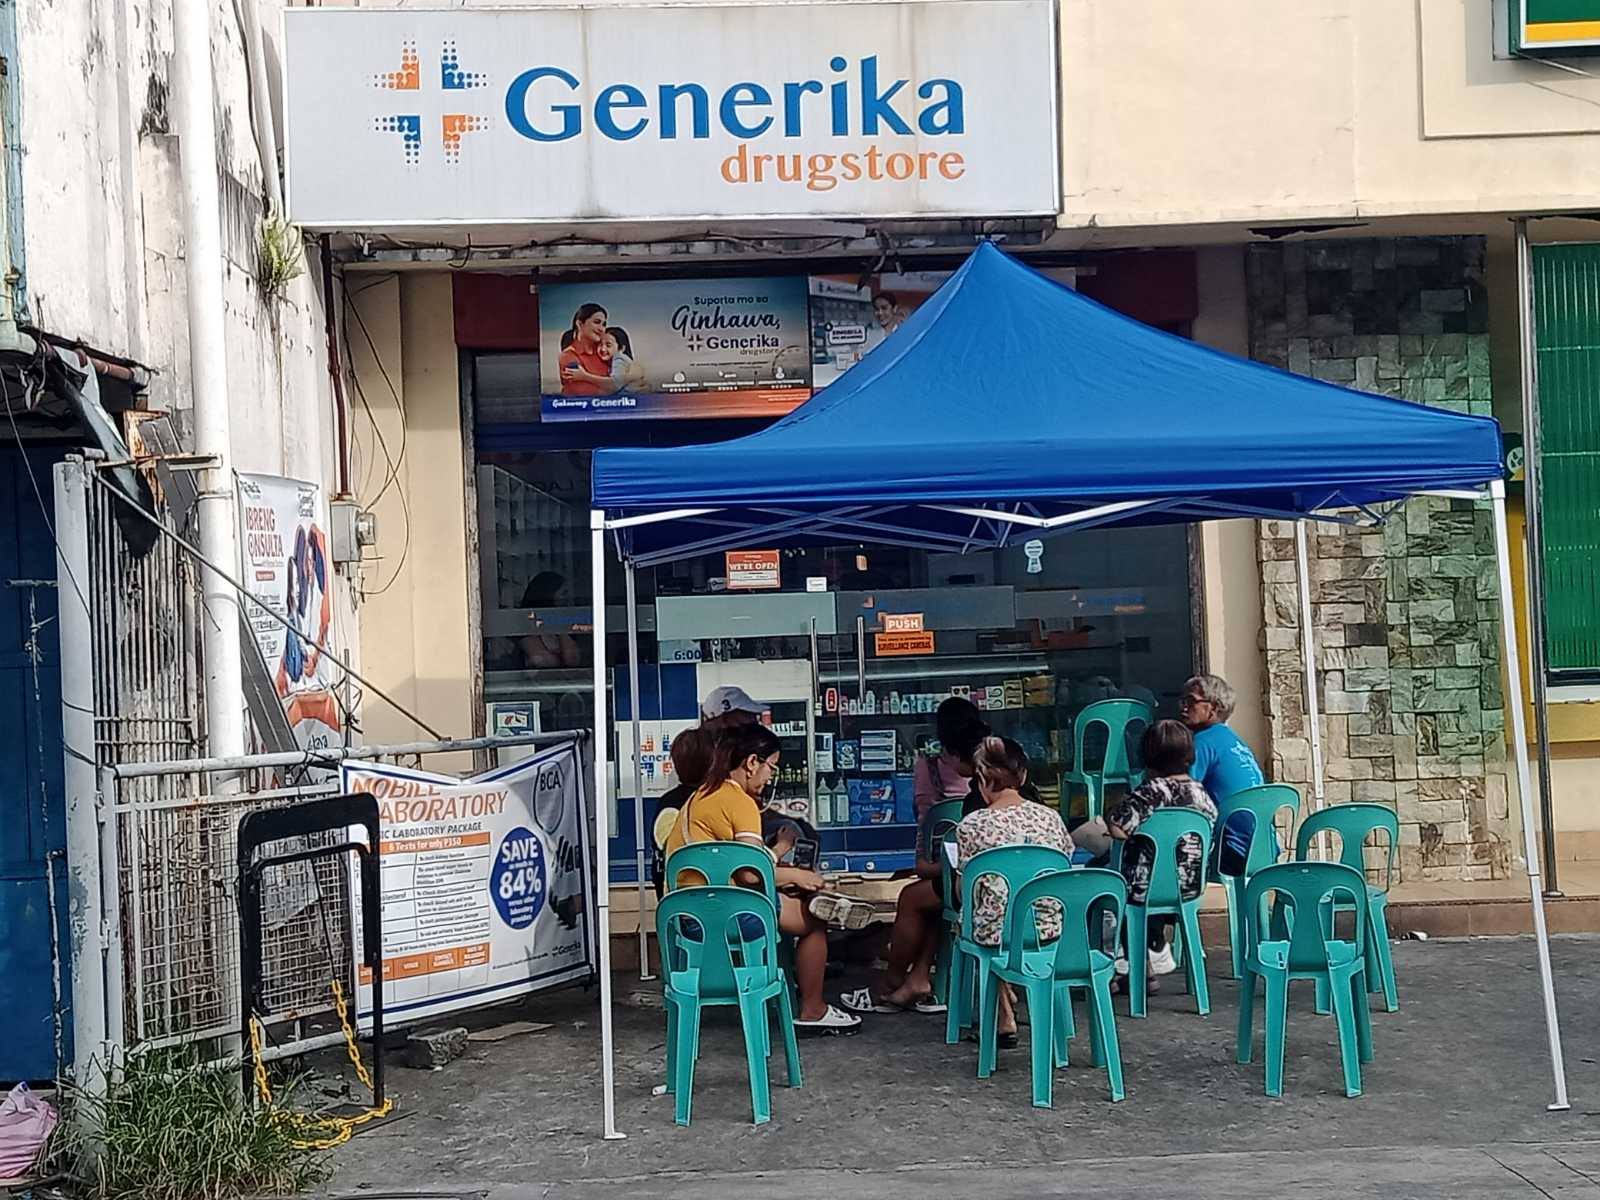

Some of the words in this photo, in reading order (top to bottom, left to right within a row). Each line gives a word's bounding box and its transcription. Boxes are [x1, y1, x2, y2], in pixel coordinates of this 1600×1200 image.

[505, 55, 966, 142] Generika
[721, 143, 966, 191] drugstore
[694, 296, 735, 307] Suporta
[671, 305, 780, 337] Ginhawa,
[706, 334, 779, 349] Generika
[592, 397, 636, 407] Generika
[246, 507, 275, 531] IBRENG
[755, 562, 778, 570] OPEN
[888, 619, 919, 628] PUSH
[674, 650, 701, 660] 6:00
[722, 699, 731, 710] 3
[539, 772, 562, 791] BCA
[380, 791, 509, 824] ABORATORY
[392, 825, 446, 838] LABORATORY
[448, 821, 482, 833] PACKAGE
[396, 841, 416, 851] Tests
[417, 840, 428, 849] for
[429, 839, 443, 849] only
[501, 837, 538, 863] SAVE
[499, 866, 542, 899] 84%
